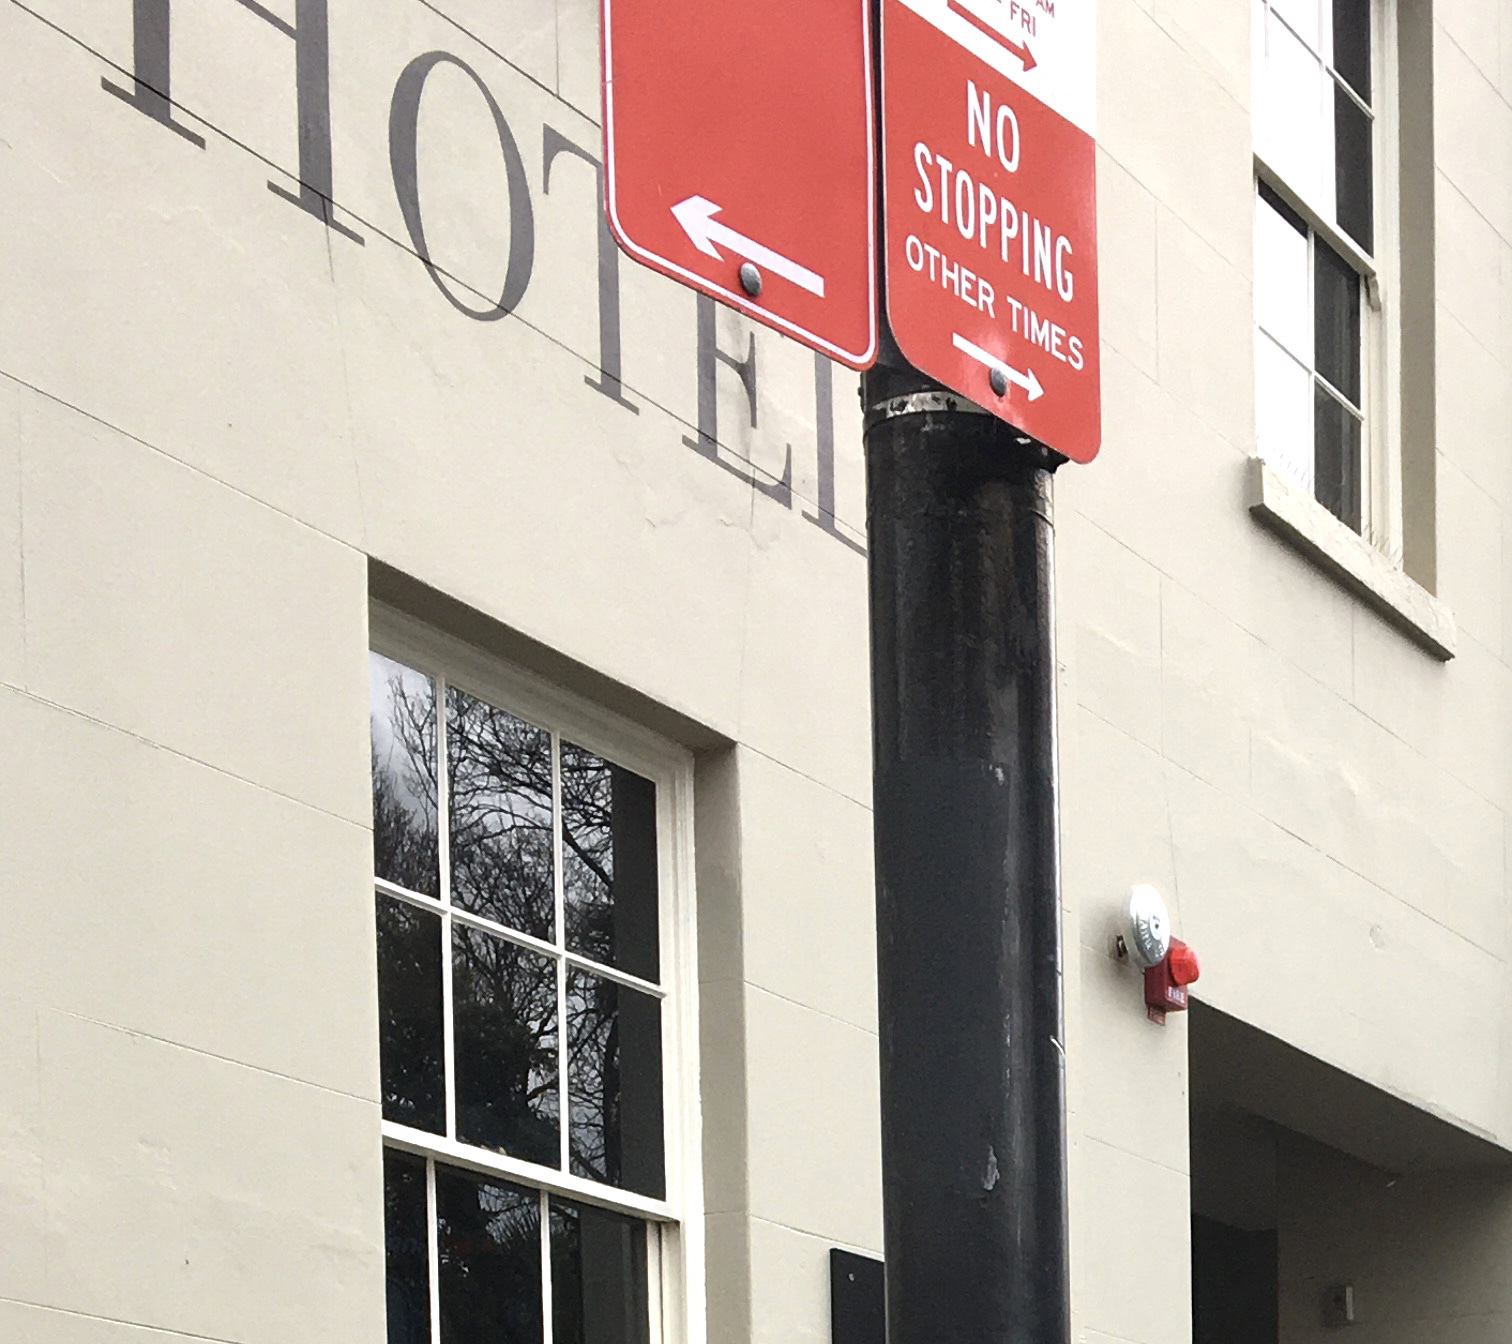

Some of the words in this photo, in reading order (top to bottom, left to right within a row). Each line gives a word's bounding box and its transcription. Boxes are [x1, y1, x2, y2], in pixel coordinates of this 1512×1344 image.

[1010, 0, 1036, 37] FRI
[967, 79, 1020, 173] NO
[914, 141, 1073, 302] STOPPING
[905, 235, 995, 319] OTHER
[1007, 295, 1083, 370] TIMES
